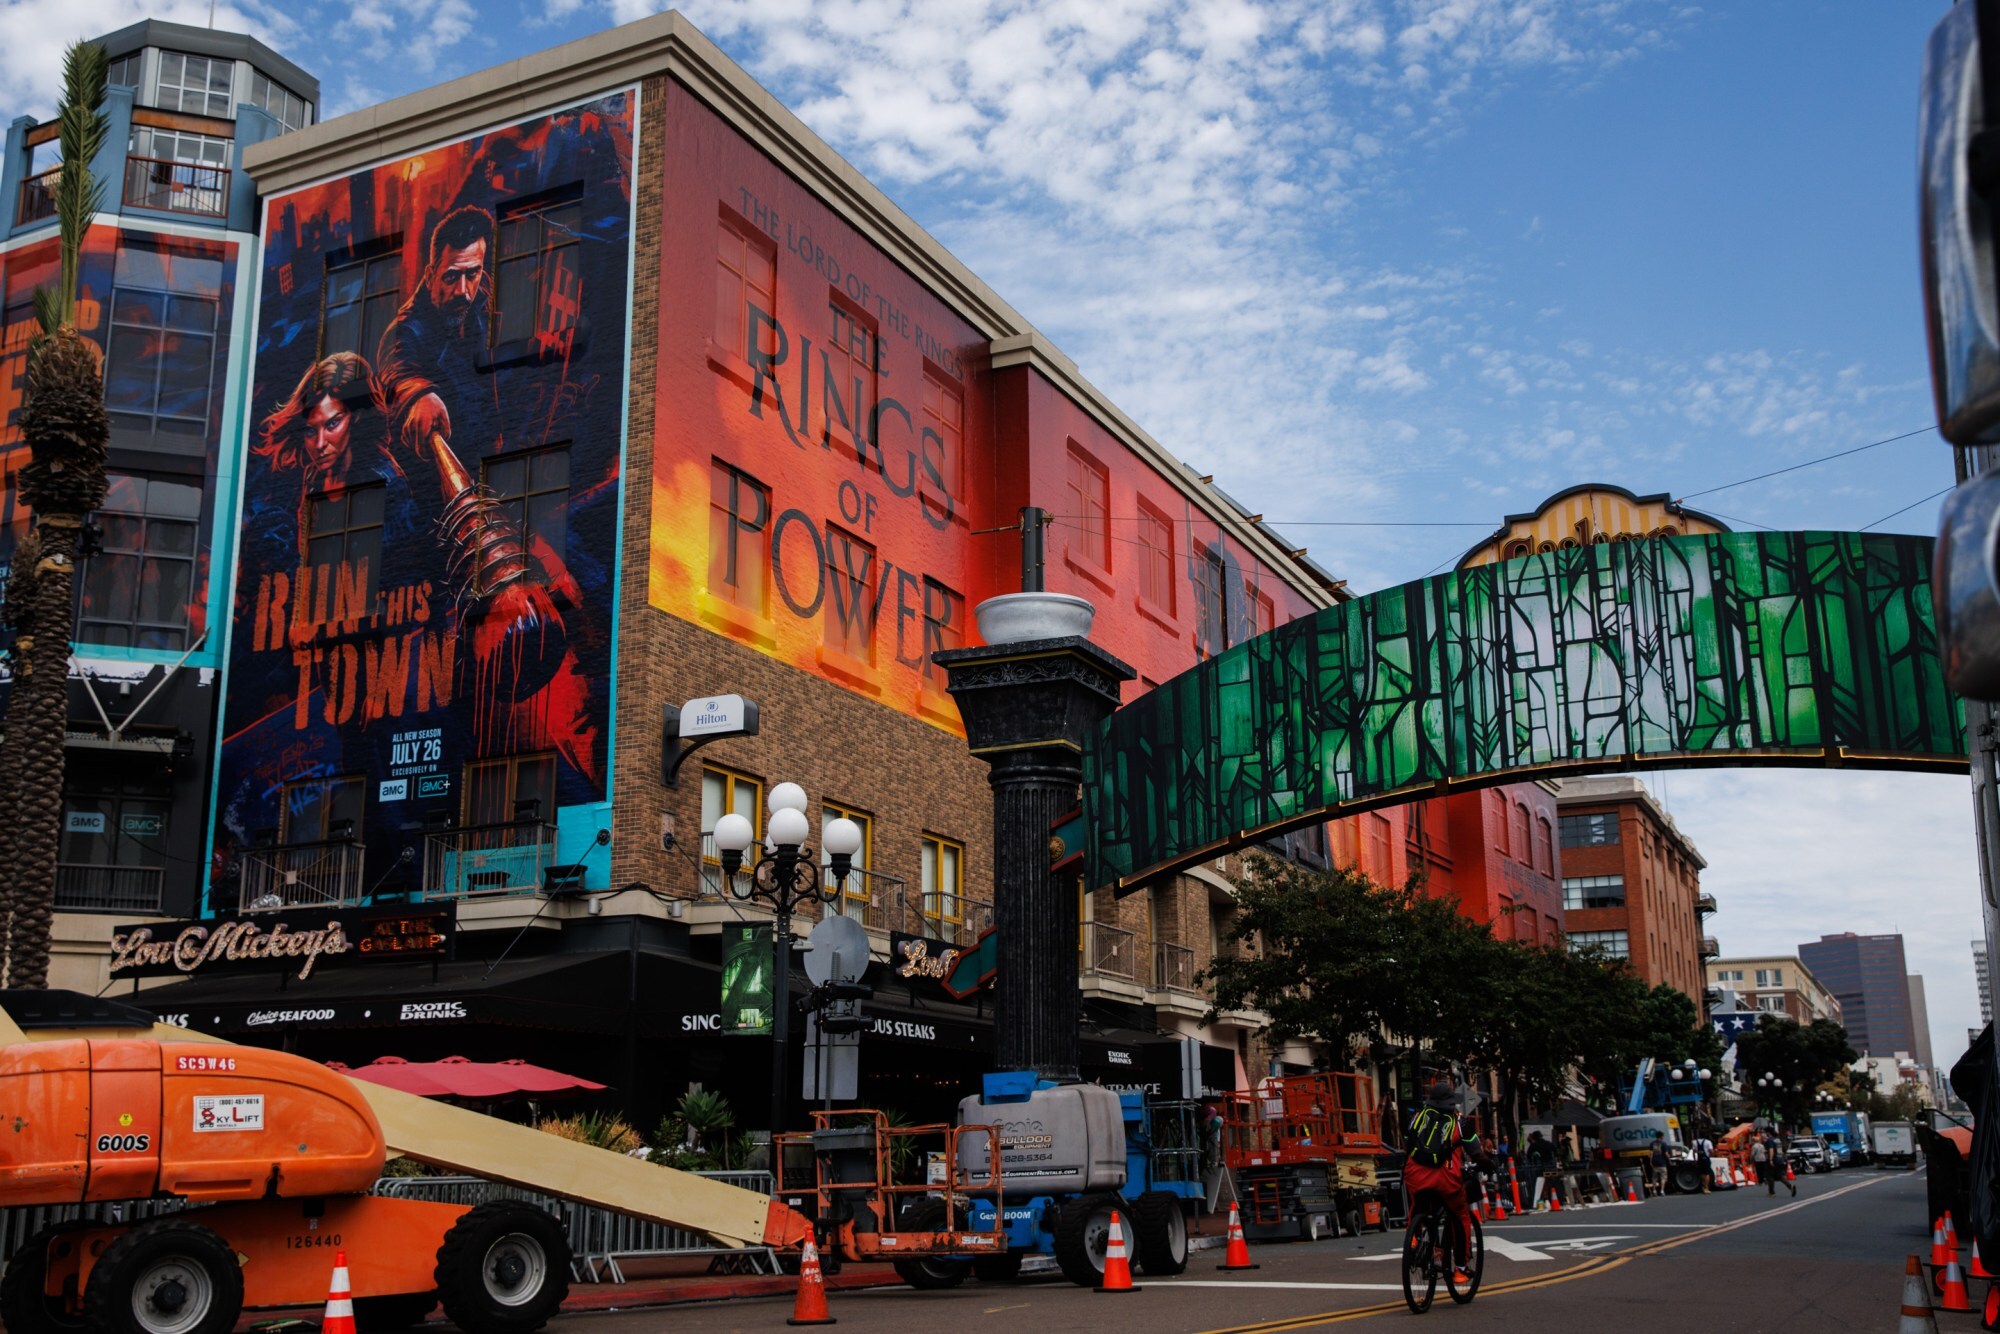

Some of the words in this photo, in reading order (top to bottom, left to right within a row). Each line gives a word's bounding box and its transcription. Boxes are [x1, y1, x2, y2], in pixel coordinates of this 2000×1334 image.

[739, 187, 780, 240] THE
[787, 224, 840, 284] LORD
[846, 273, 871, 307] OF
[876, 294, 910, 340] THE
[915, 324, 963, 381] RINGS
[829, 302, 890, 379] THE
[747, 299, 954, 531] RINGS
[838, 480, 878, 533] OF
[723, 464, 952, 680] POWER
[253, 556, 368, 651] RUN
[370, 580, 433, 628] THIS
[293, 627, 457, 730] TOWN
[696, 714, 728, 725] Hilton
[392, 733, 403, 742] ALL
[404, 731, 418, 741] NEW
[418, 728, 442, 739] SEASON
[390, 741, 421, 766] JULY
[423, 738, 442, 761] 26
[391, 766, 427, 776] EXCLUSIVELY
[428, 764, 437, 772] ON
[372, 920, 395, 936] AT
[111, 927, 175, 972] Lou
[174, 921, 353, 980] Mickey's
[359, 933, 441, 953] GASLAMP
[400, 1009, 467, 1020] DRINKS
[401, 1001, 463, 1012] EXOTIC
[246, 1010, 279, 1026] Choice
[278, 1008, 336, 1021] SEAFOOD
[894, 1021, 936, 1040] STEAKS
[1107, 1050, 1130, 1059] EXOTIC
[1108, 1056, 1133, 1064] DRINKS
[178, 1056, 236, 1070] SC9W46
[233, 1107, 260, 1122] LIFT
[1613, 1126, 1658, 1141] Genie
[97, 1134, 150, 1152] 600S
[985, 1153, 1053, 1164] 8-828-5364
[980, 1211, 999, 1220] Geni
[1004, 1211, 1031, 1219] BOOM
[287, 1234, 342, 1249] 126440
